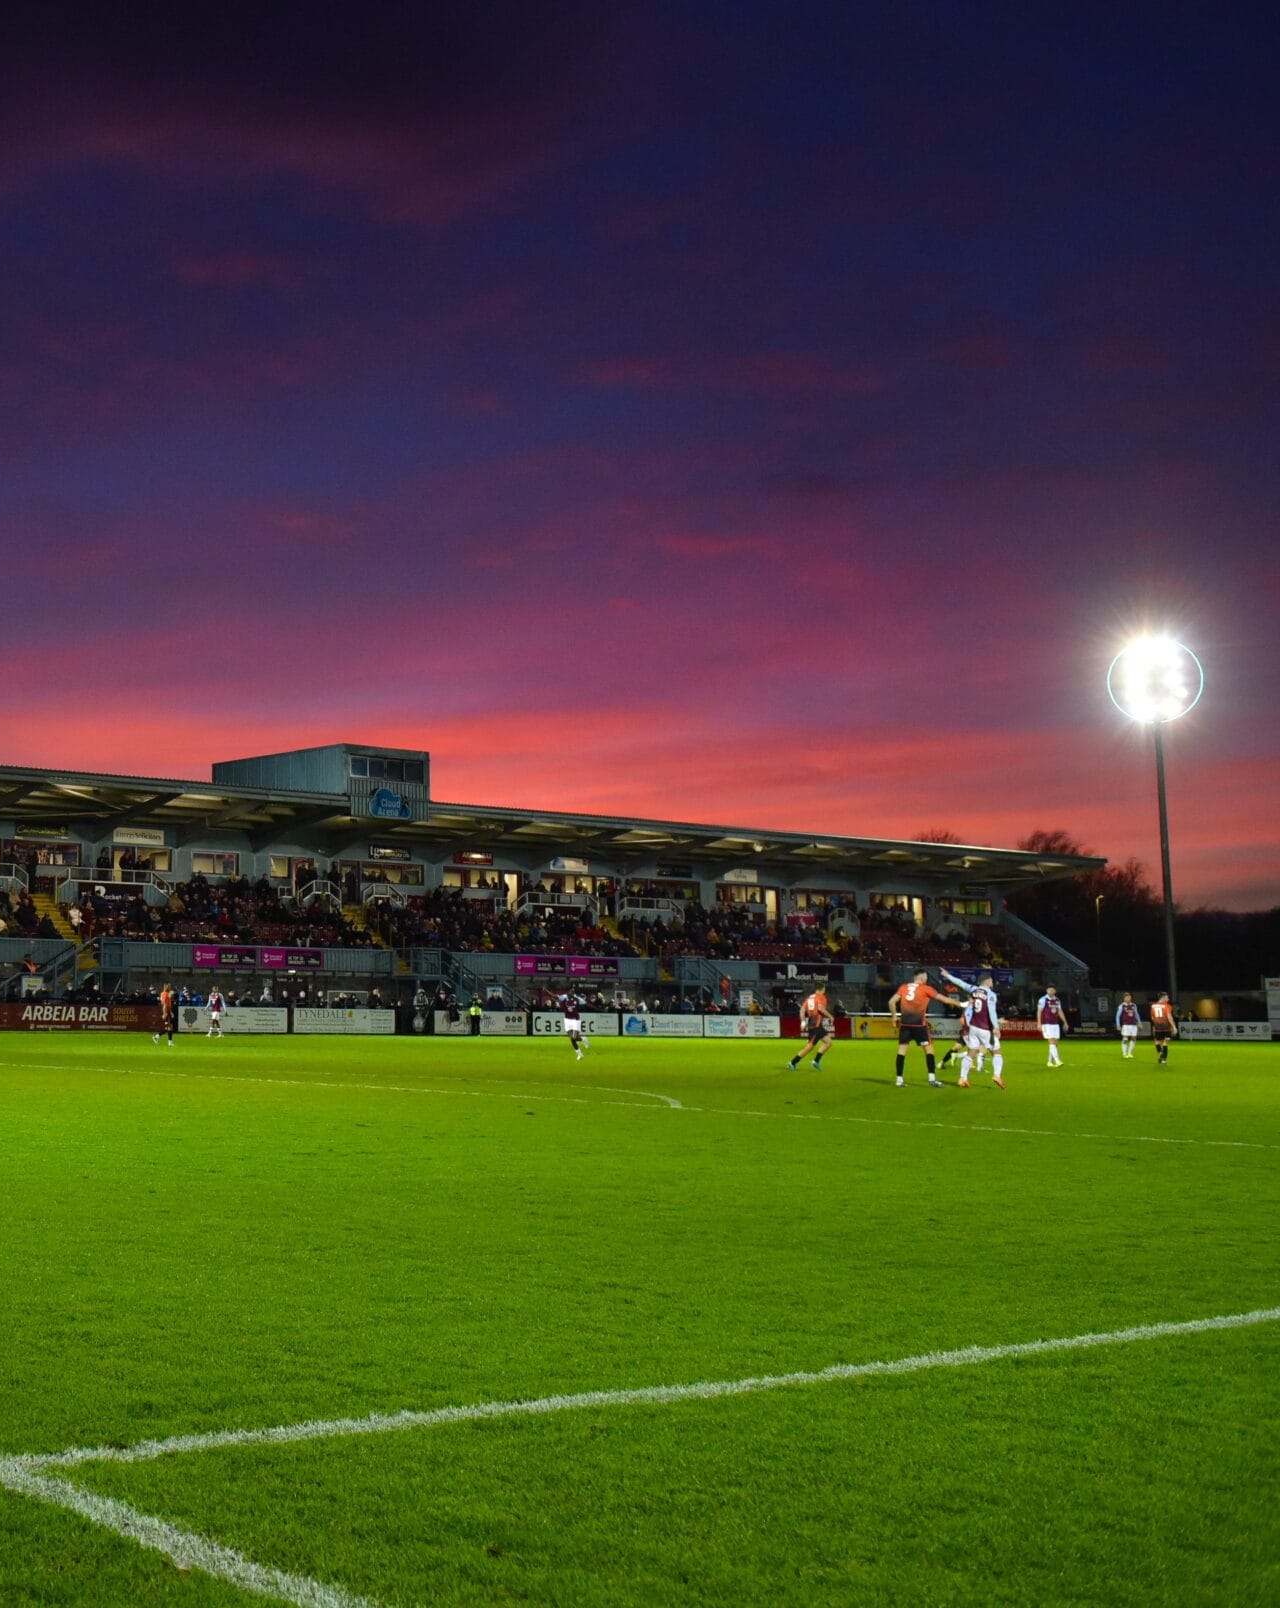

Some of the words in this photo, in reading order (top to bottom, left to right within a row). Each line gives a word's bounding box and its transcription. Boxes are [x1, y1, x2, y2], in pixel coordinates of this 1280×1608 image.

[381, 798, 401, 808] Cloud
[378, 807, 399, 817] Arena
[776, 972, 786, 980] The
[906, 987, 916, 1001] 3
[974, 999, 983, 1013] 9
[22, 1005, 76, 1021] ARBEIA
[79, 1006, 109, 1022] BAR
[1154, 1007, 1164, 1018] 11
[112, 1014, 138, 1023] SHIELDS
[1180, 1026, 1210, 1034] Puman
